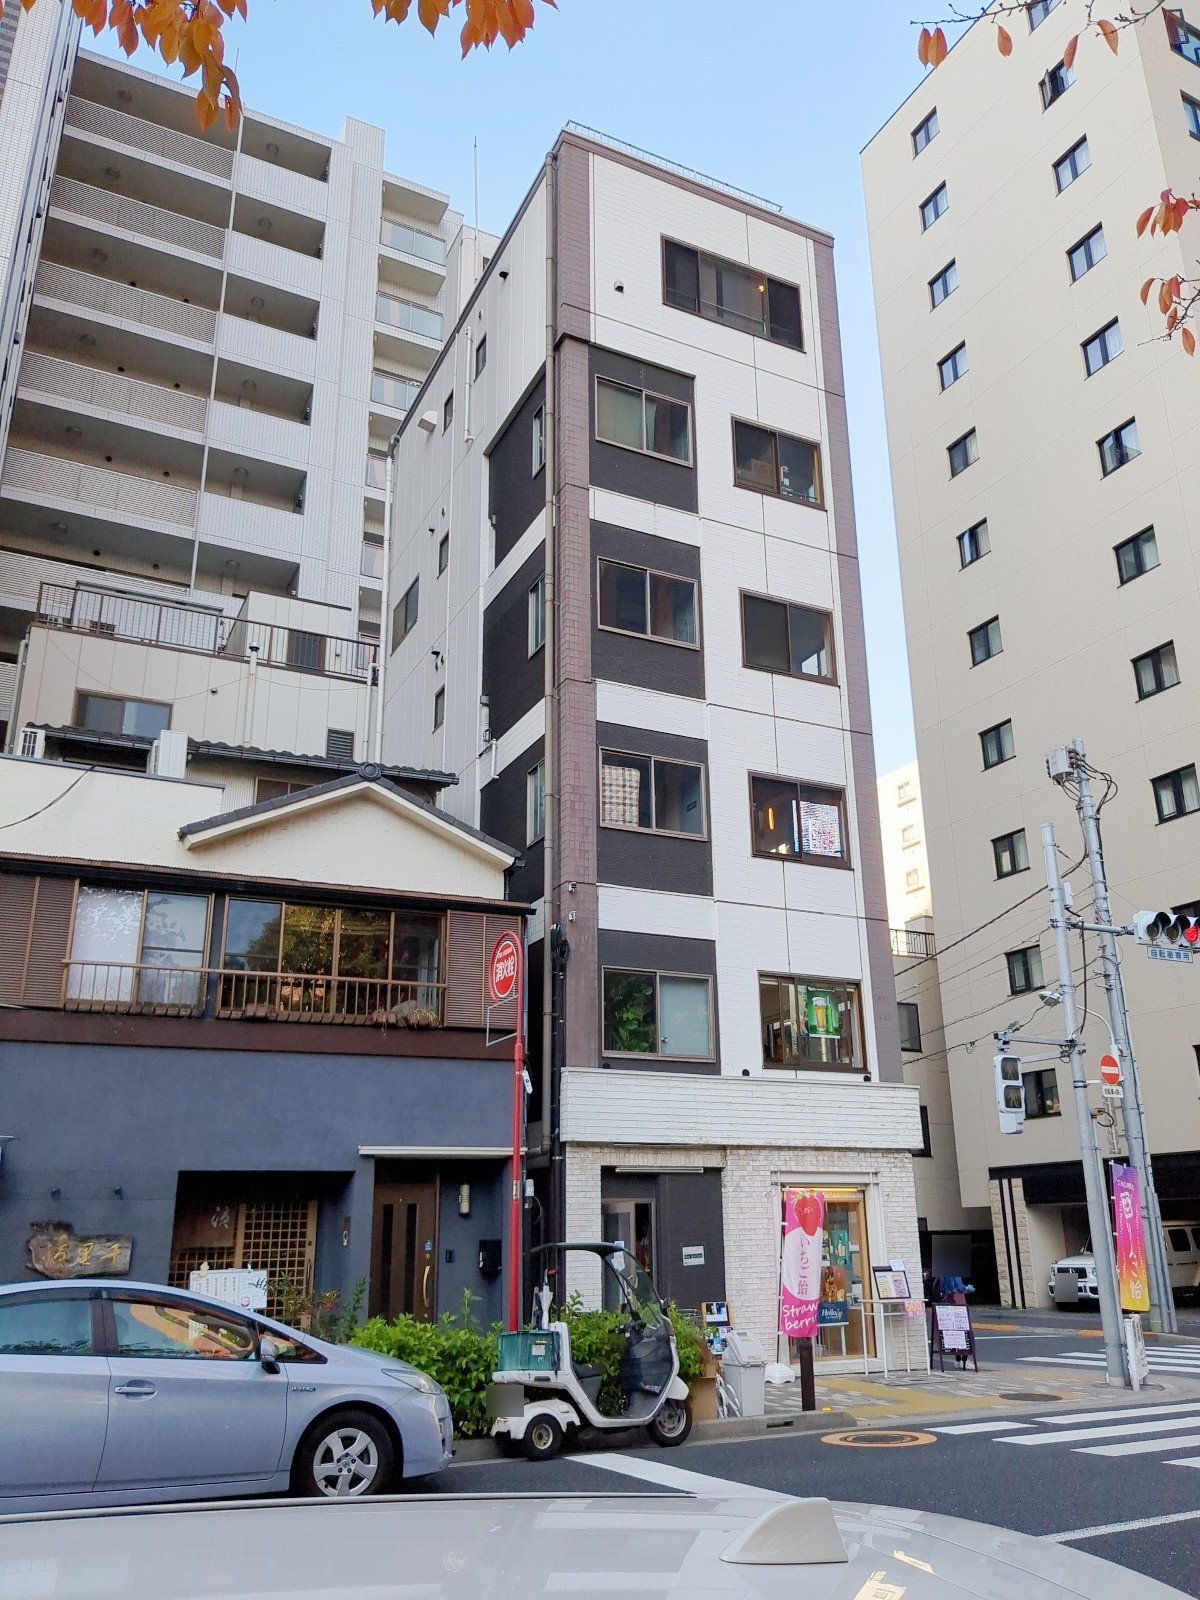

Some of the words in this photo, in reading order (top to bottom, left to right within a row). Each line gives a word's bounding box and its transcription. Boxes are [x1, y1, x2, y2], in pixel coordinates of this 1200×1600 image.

[496, 955, 515, 983] 消火栓
[797, 1237, 811, 1295] いちご飴
[782, 1302, 818, 1318] Straw
